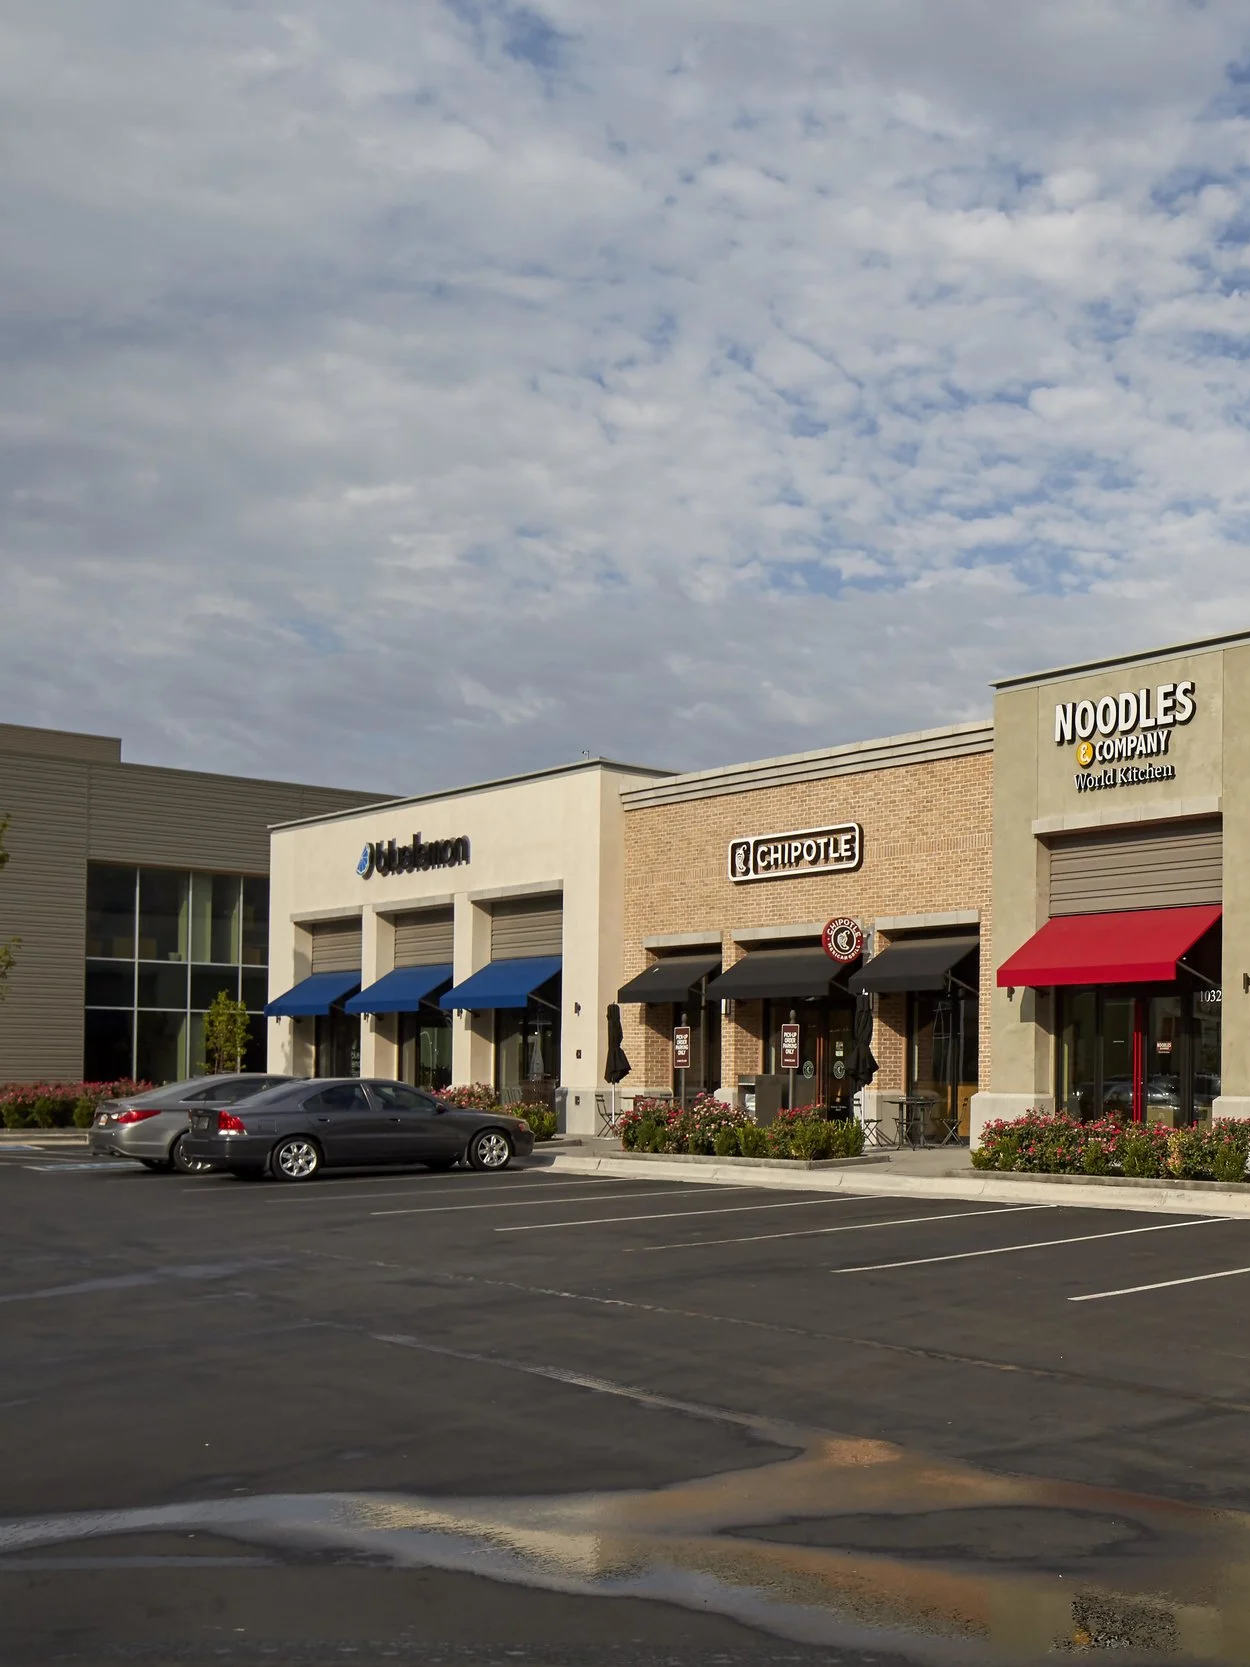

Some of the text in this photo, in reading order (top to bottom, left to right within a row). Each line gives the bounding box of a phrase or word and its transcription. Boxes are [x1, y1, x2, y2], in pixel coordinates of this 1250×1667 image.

[1054, 680, 1194, 743] NOODLES
[1095, 730, 1169, 761] COMPANY
[1074, 763, 1173, 790] World Kitchen
[757, 835, 852, 867] CHIPOTLE
[827, 918, 862, 938] CHIPOTLE
[828, 943, 848, 960] MEXICAN
[1200, 990, 1222, 1002] 1032
